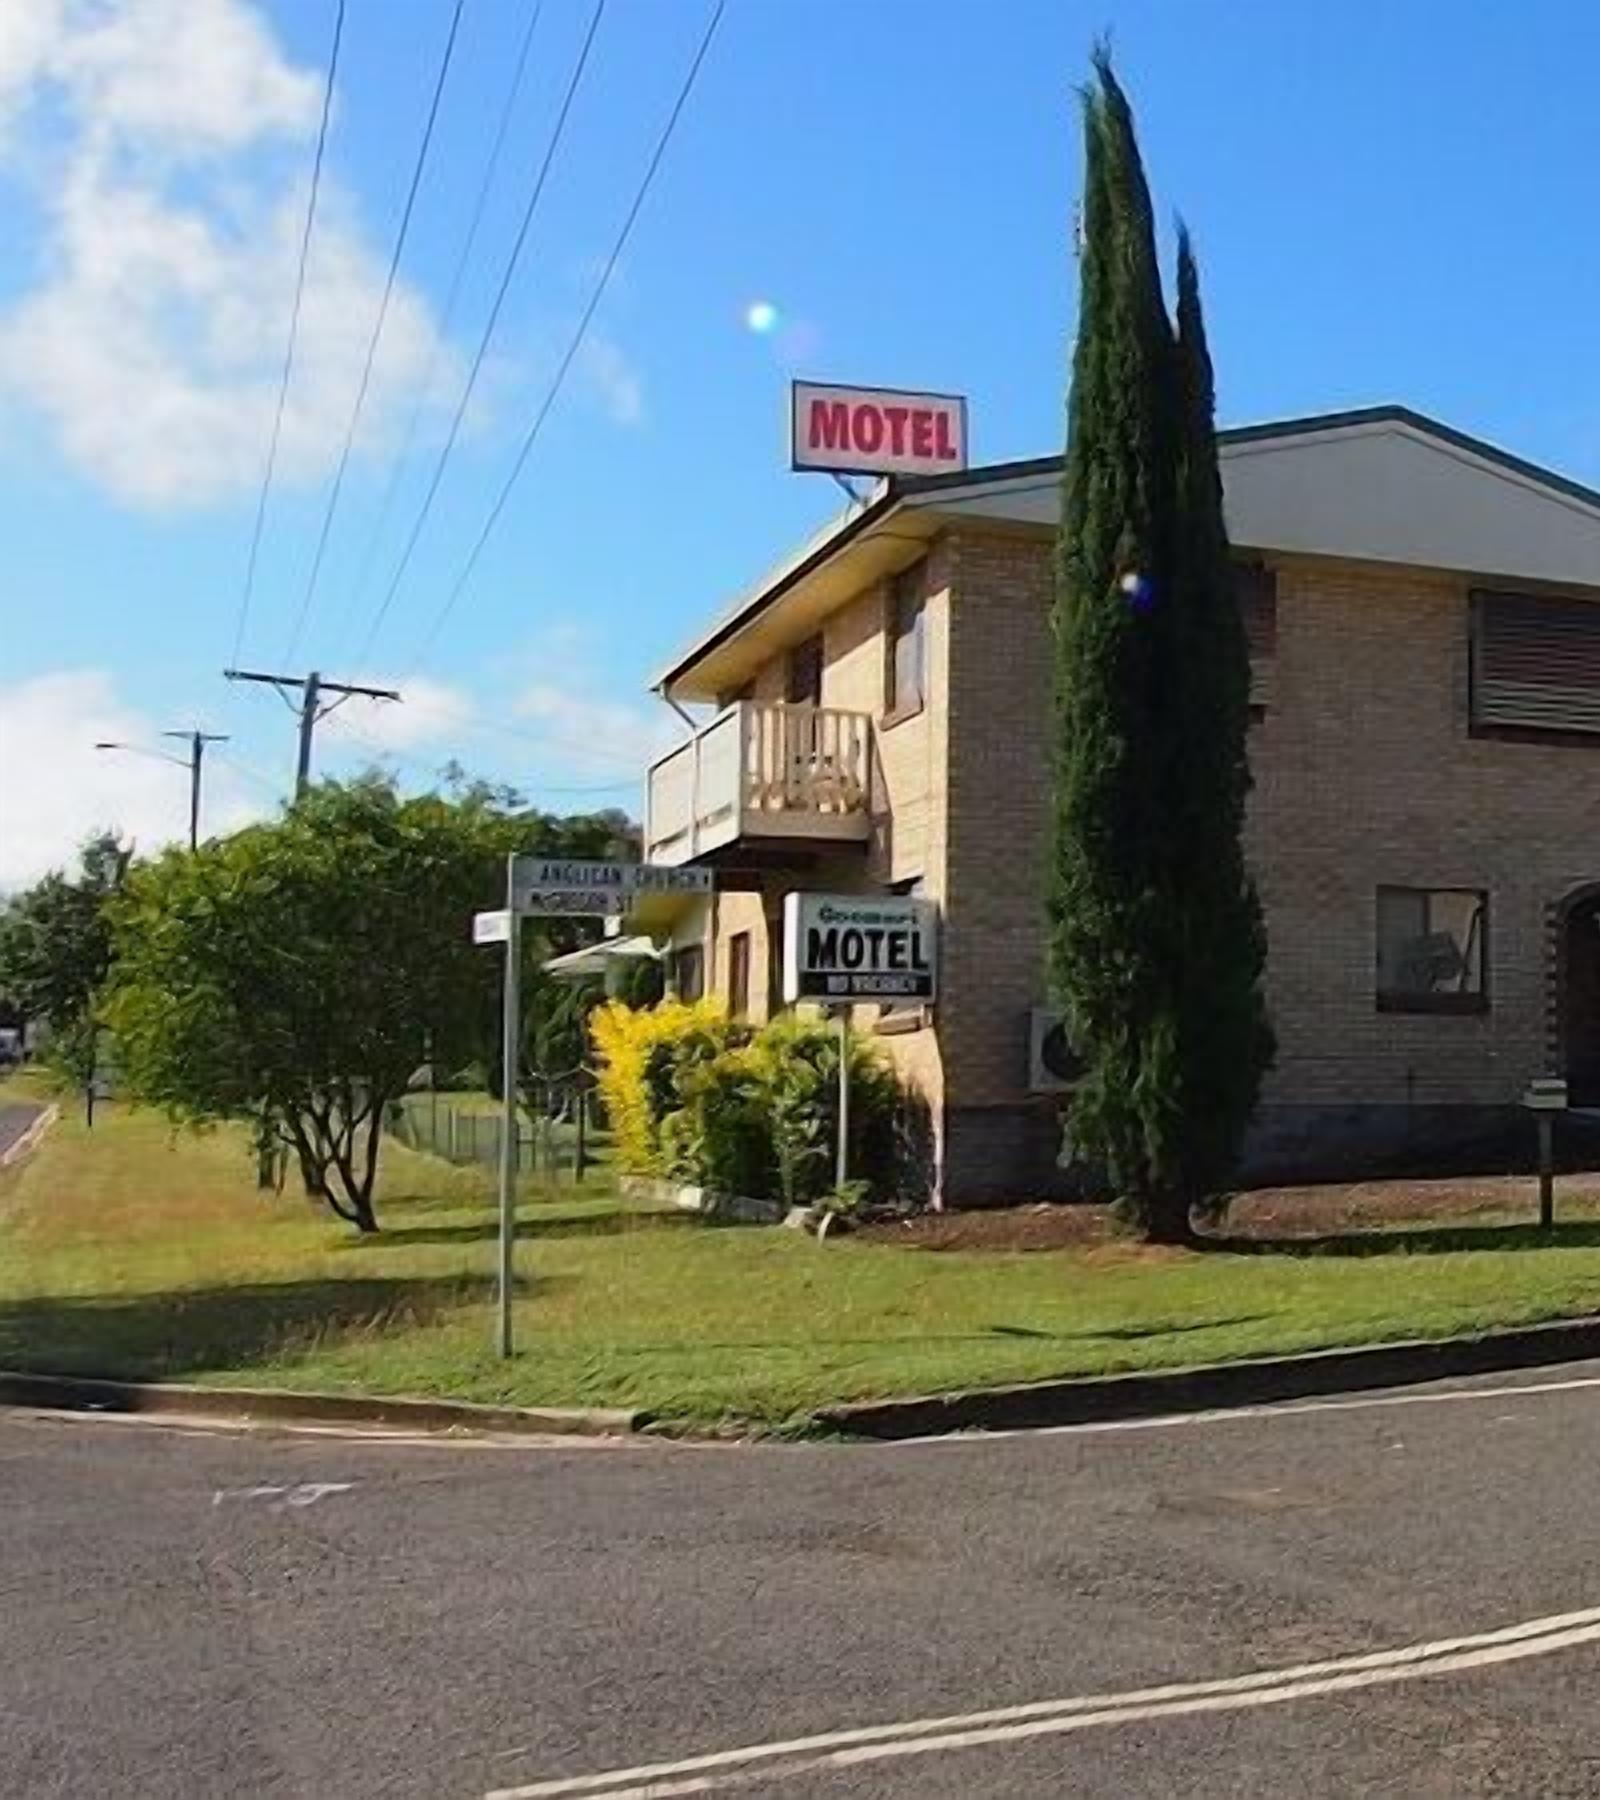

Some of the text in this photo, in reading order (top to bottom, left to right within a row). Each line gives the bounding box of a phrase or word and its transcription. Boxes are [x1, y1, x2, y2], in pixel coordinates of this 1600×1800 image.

[808, 399, 957, 461] MOTEL
[540, 864, 622, 884] ANGLICAN
[807, 927, 929, 969] MOTEL
